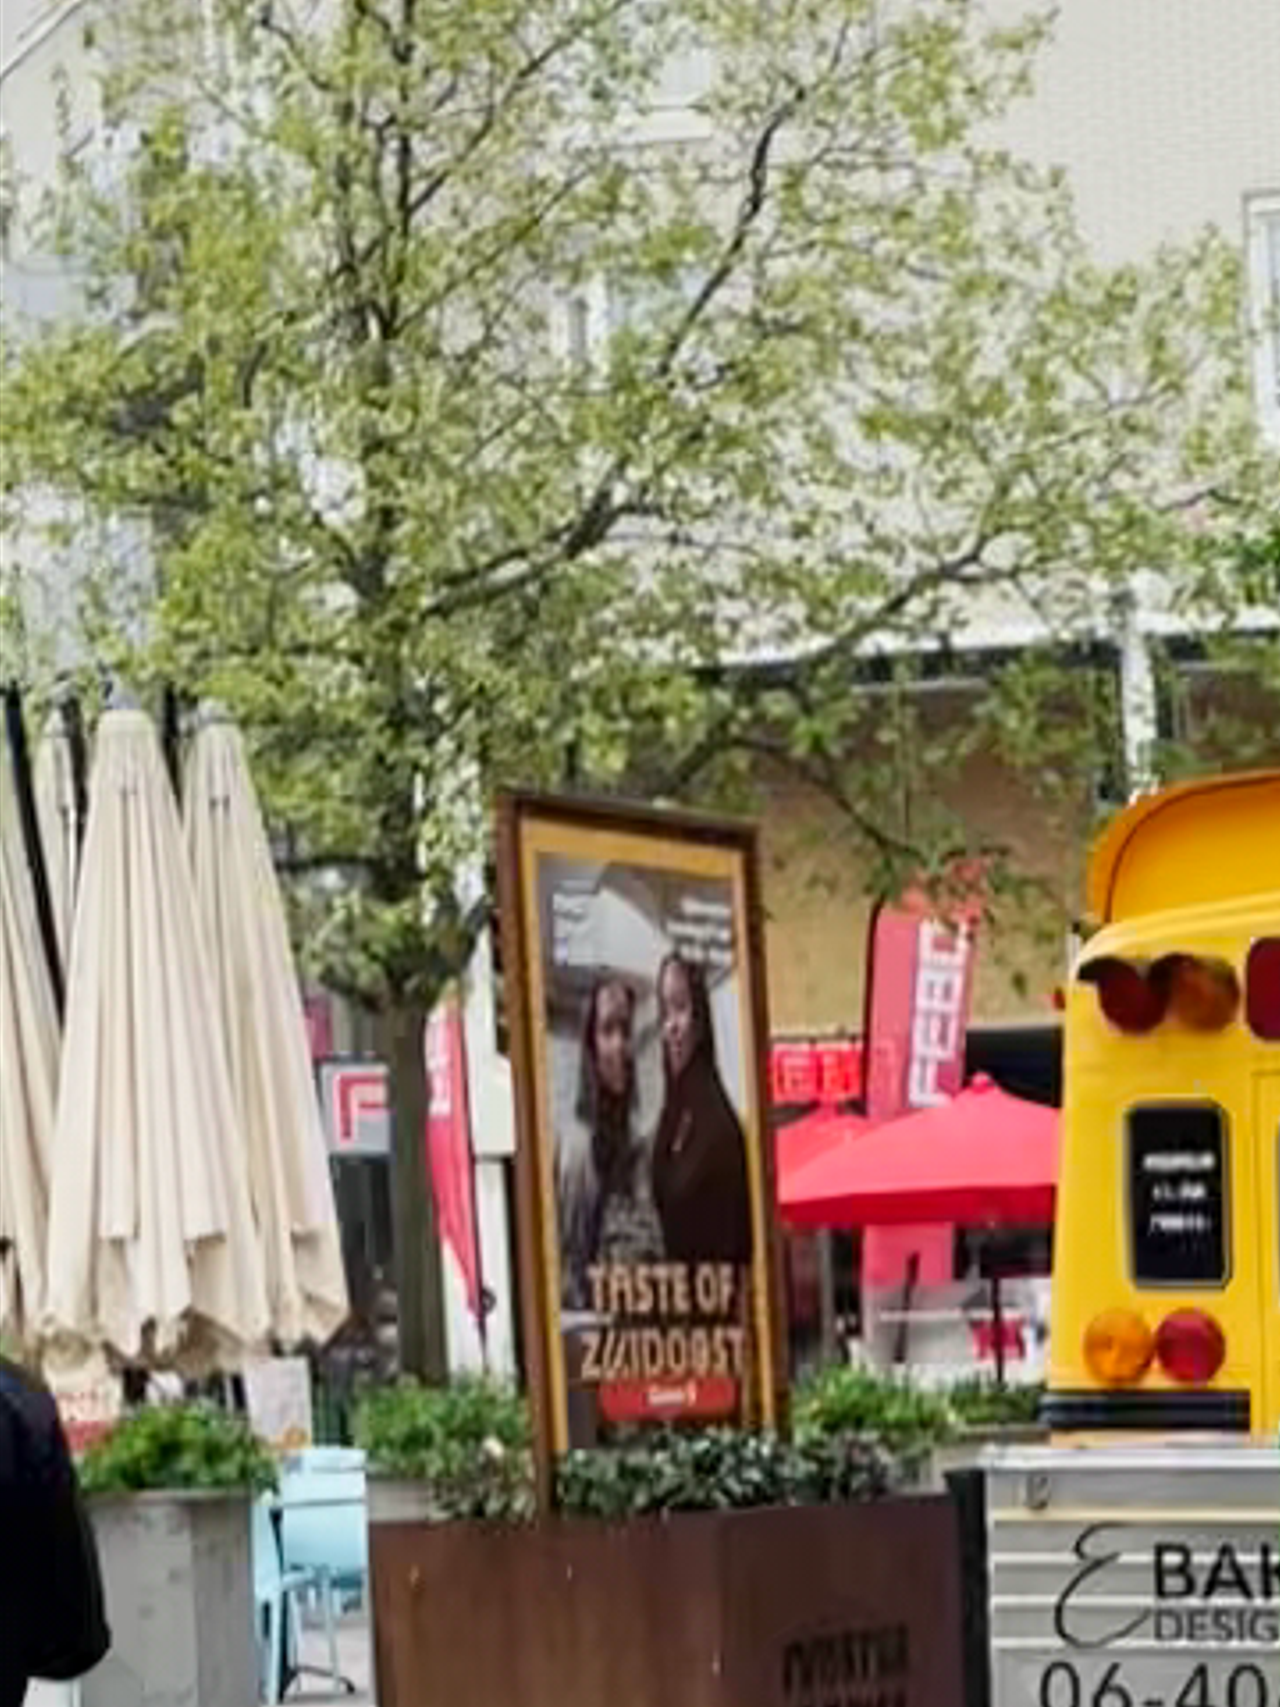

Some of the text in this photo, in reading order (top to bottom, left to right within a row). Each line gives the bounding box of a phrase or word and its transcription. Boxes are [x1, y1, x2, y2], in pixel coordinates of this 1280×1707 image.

[587, 1261, 733, 1314] TASTE OF
[580, 1327, 745, 1380] ZUIDOOST
